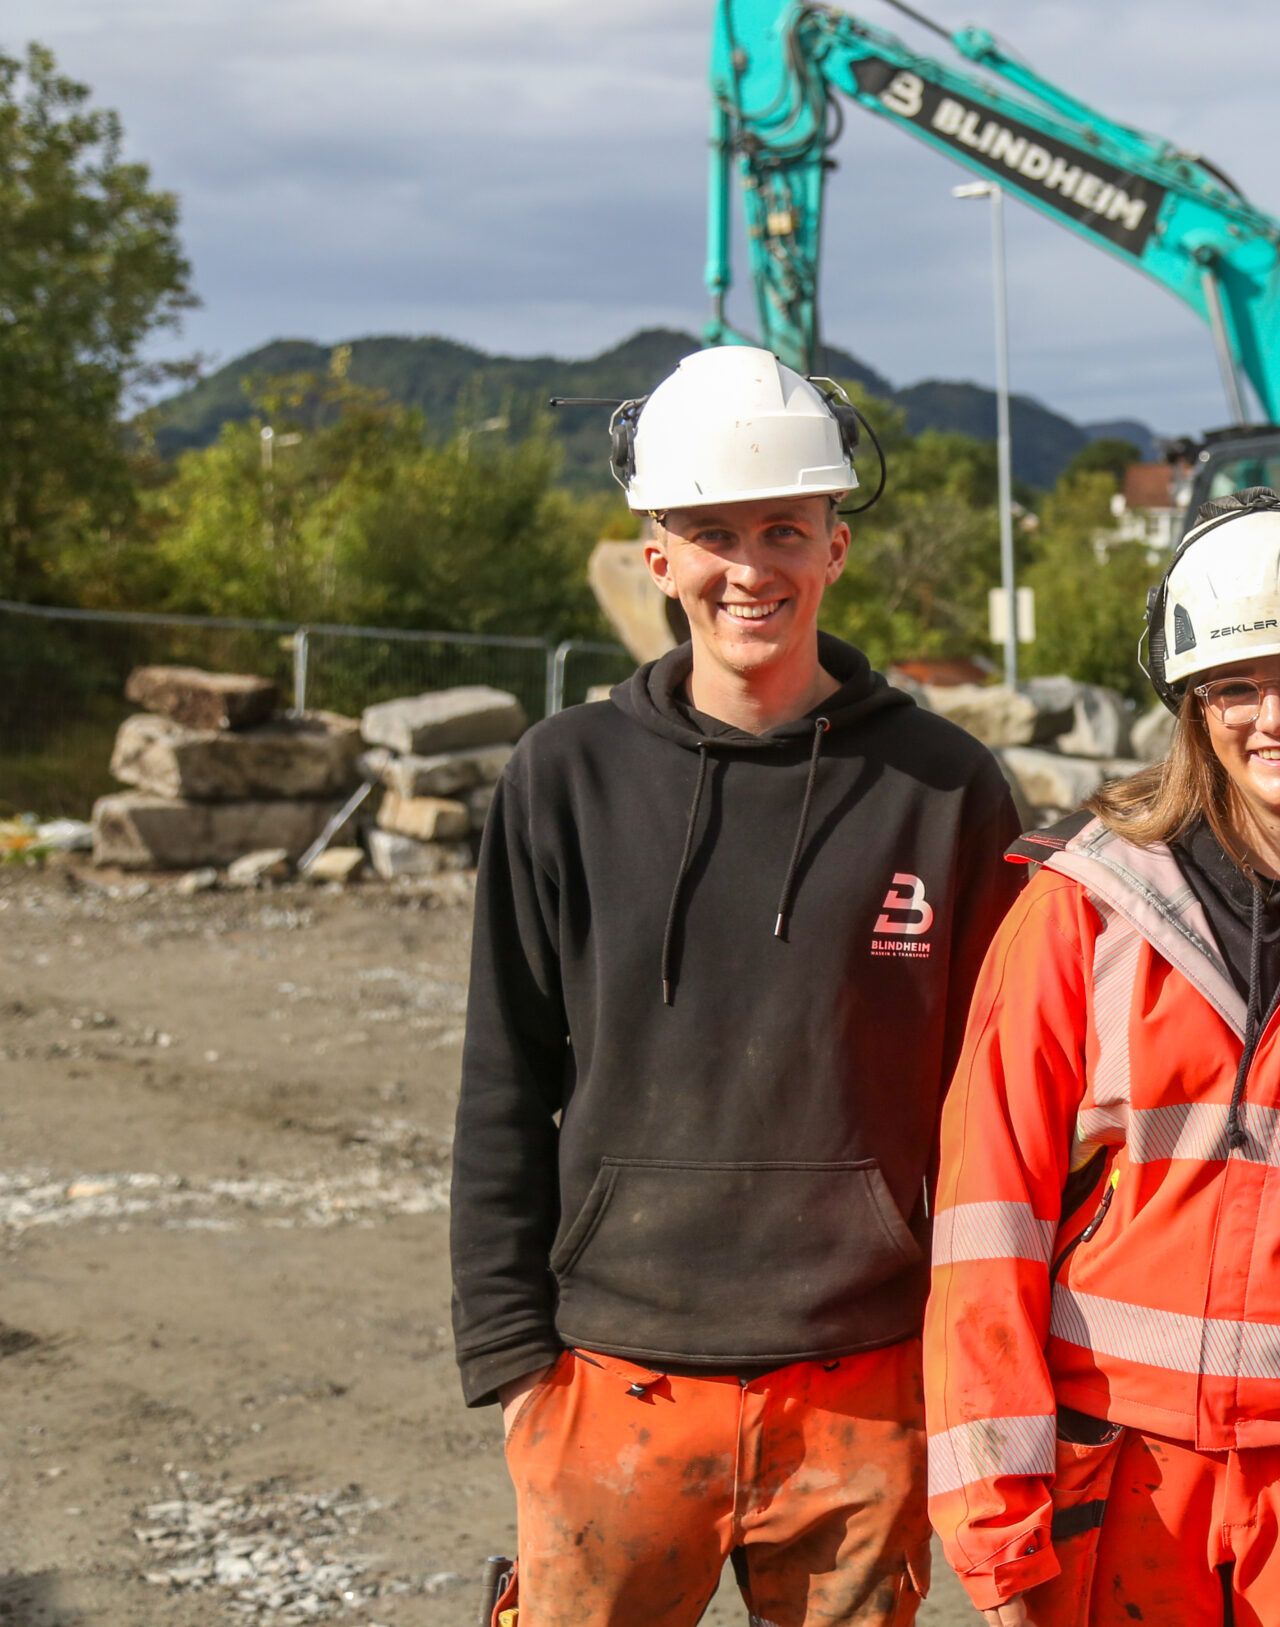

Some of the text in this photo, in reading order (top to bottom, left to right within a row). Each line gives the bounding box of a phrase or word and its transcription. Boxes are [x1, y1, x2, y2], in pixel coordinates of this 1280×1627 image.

[931, 97, 1147, 231] BLINDHEIM
[1210, 619, 1279, 640] ZEKLER
[871, 940, 931, 953] BLINDHEIM
